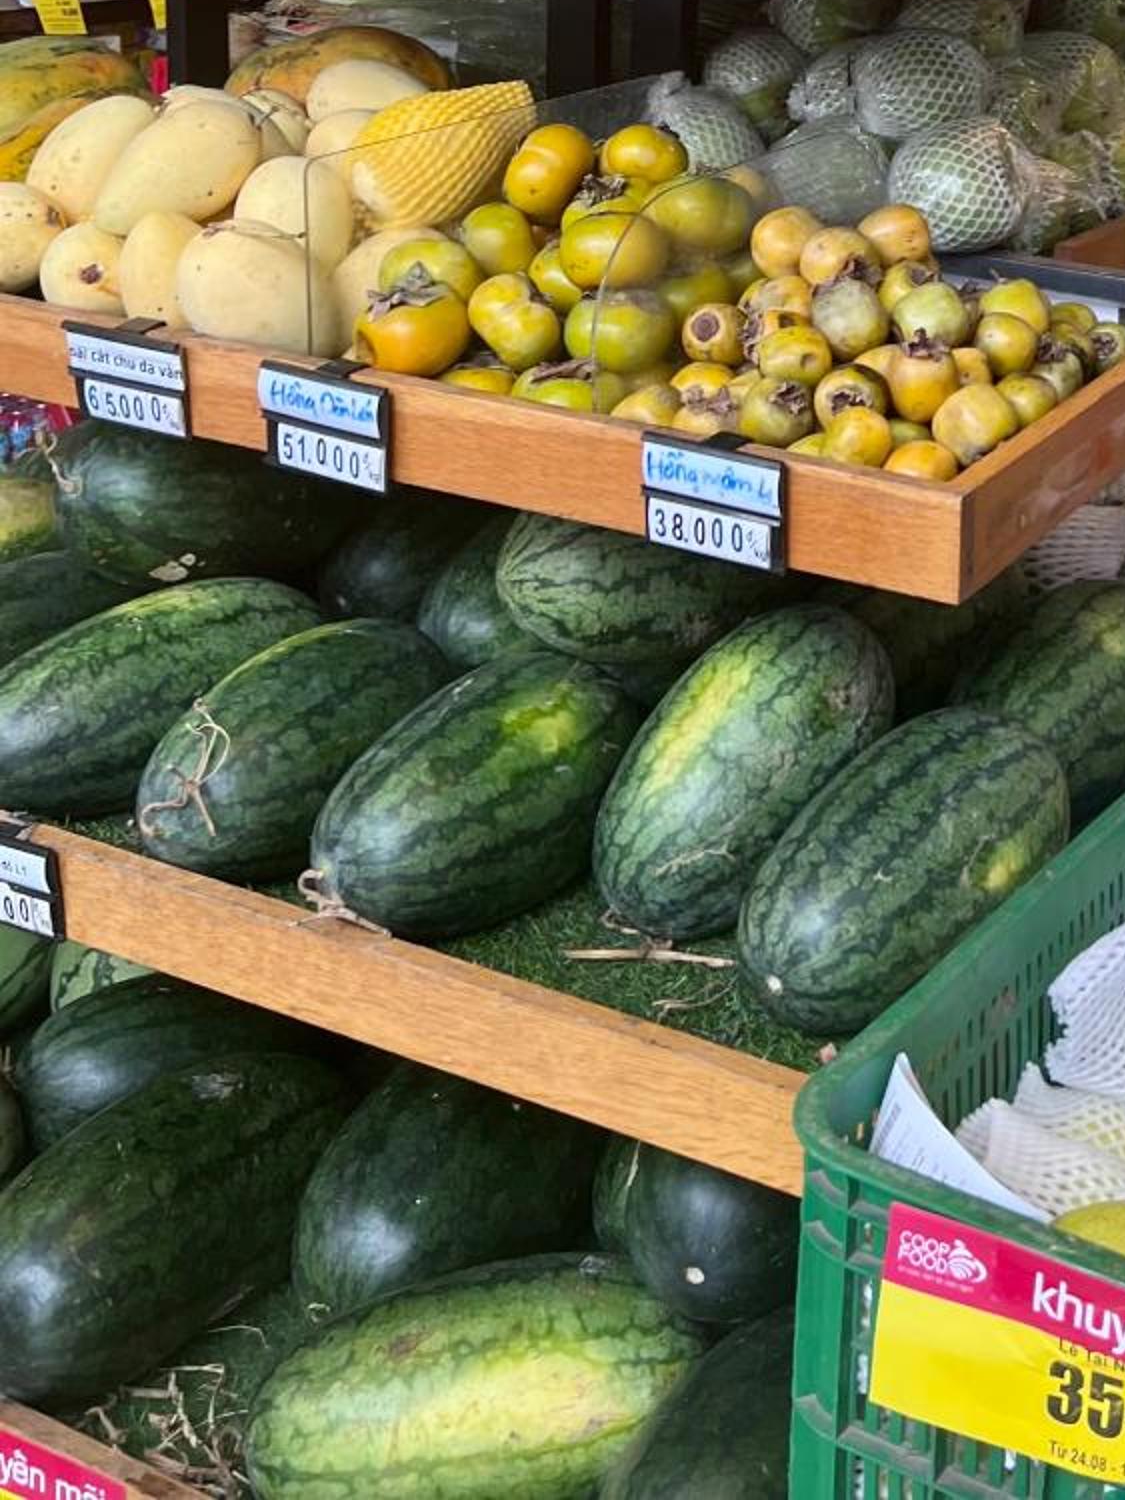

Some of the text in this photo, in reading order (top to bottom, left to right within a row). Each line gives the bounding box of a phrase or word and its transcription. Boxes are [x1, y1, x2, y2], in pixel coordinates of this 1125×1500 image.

[140, 360, 155, 375] da
[282, 433, 360, 479] 51.000
[647, 451, 698, 493] Hồng
[655, 508, 743, 552] 38.000
[899, 1229, 951, 1255] COOP
[897, 1245, 947, 1274] FOOD
[1071, 1447, 1107, 1473] 24.08
